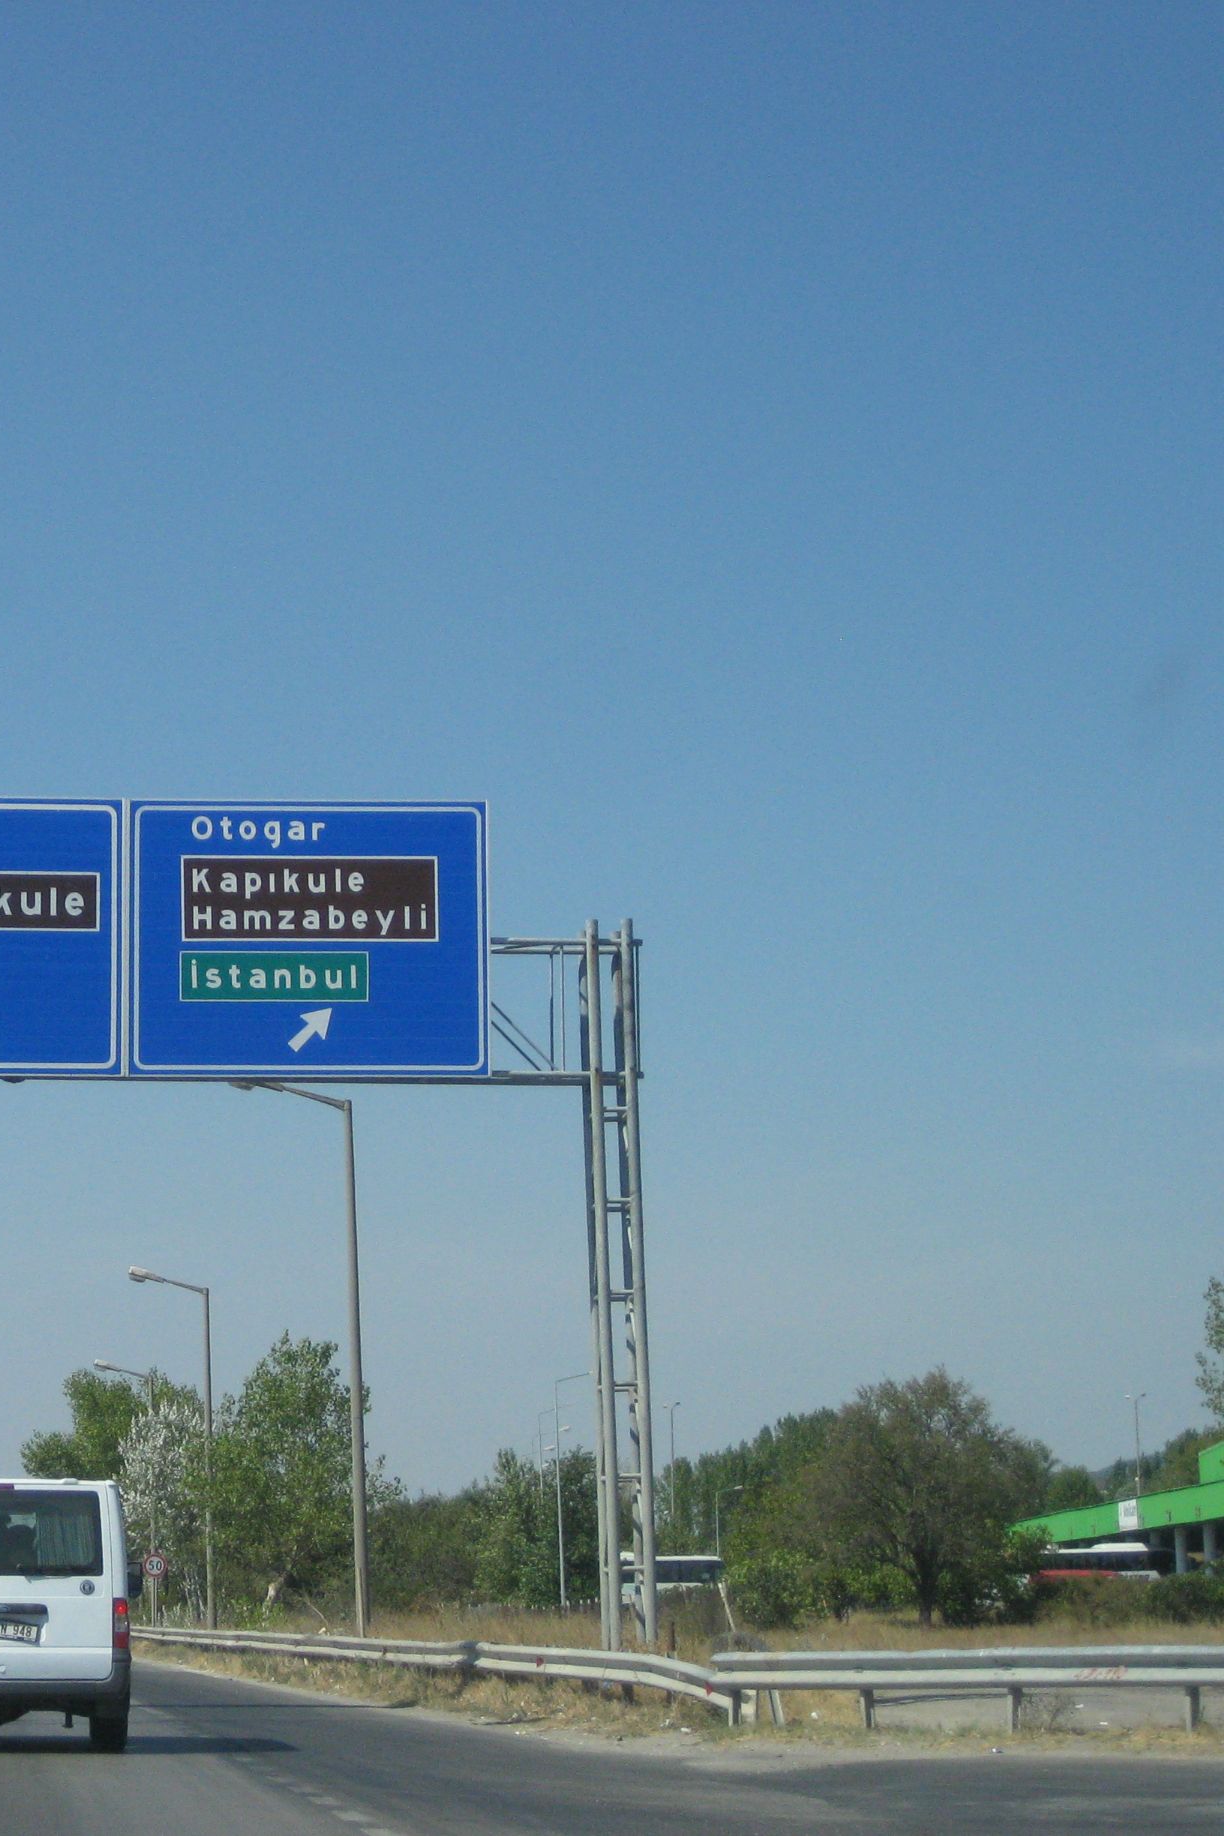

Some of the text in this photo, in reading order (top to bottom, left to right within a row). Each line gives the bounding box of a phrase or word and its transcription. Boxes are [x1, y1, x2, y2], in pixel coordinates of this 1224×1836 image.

[191, 815, 326, 848] Otogar
[191, 867, 365, 899] Kapıkule
[192, 903, 427, 935] Hamzabeyli
[190, 958, 357, 989] İstanbul
[148, 1559, 162, 1571] 50
[13, 1624, 33, 1638] 948
